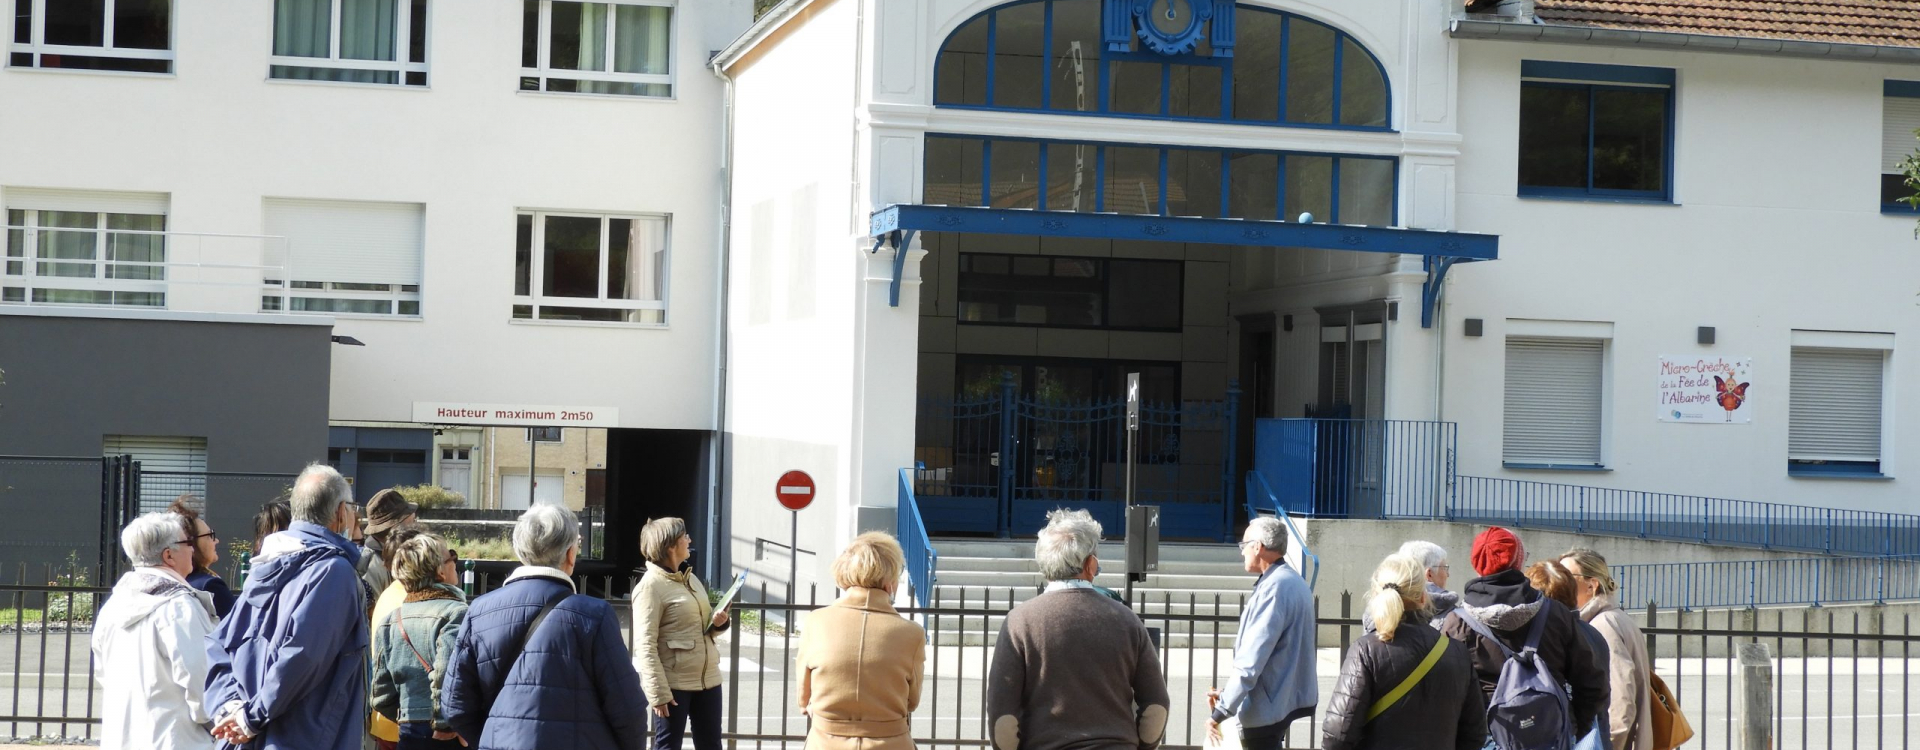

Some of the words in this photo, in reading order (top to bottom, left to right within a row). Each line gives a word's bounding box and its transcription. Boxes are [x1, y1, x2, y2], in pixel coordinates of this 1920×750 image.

[1661, 381, 1669, 389] de
[1696, 374, 1709, 387] de
[1661, 391, 1711, 405] l'Albarine
[437, 407, 488, 418] Hauteur
[495, 409, 556, 420] maximum
[560, 411, 594, 421] 2m50
